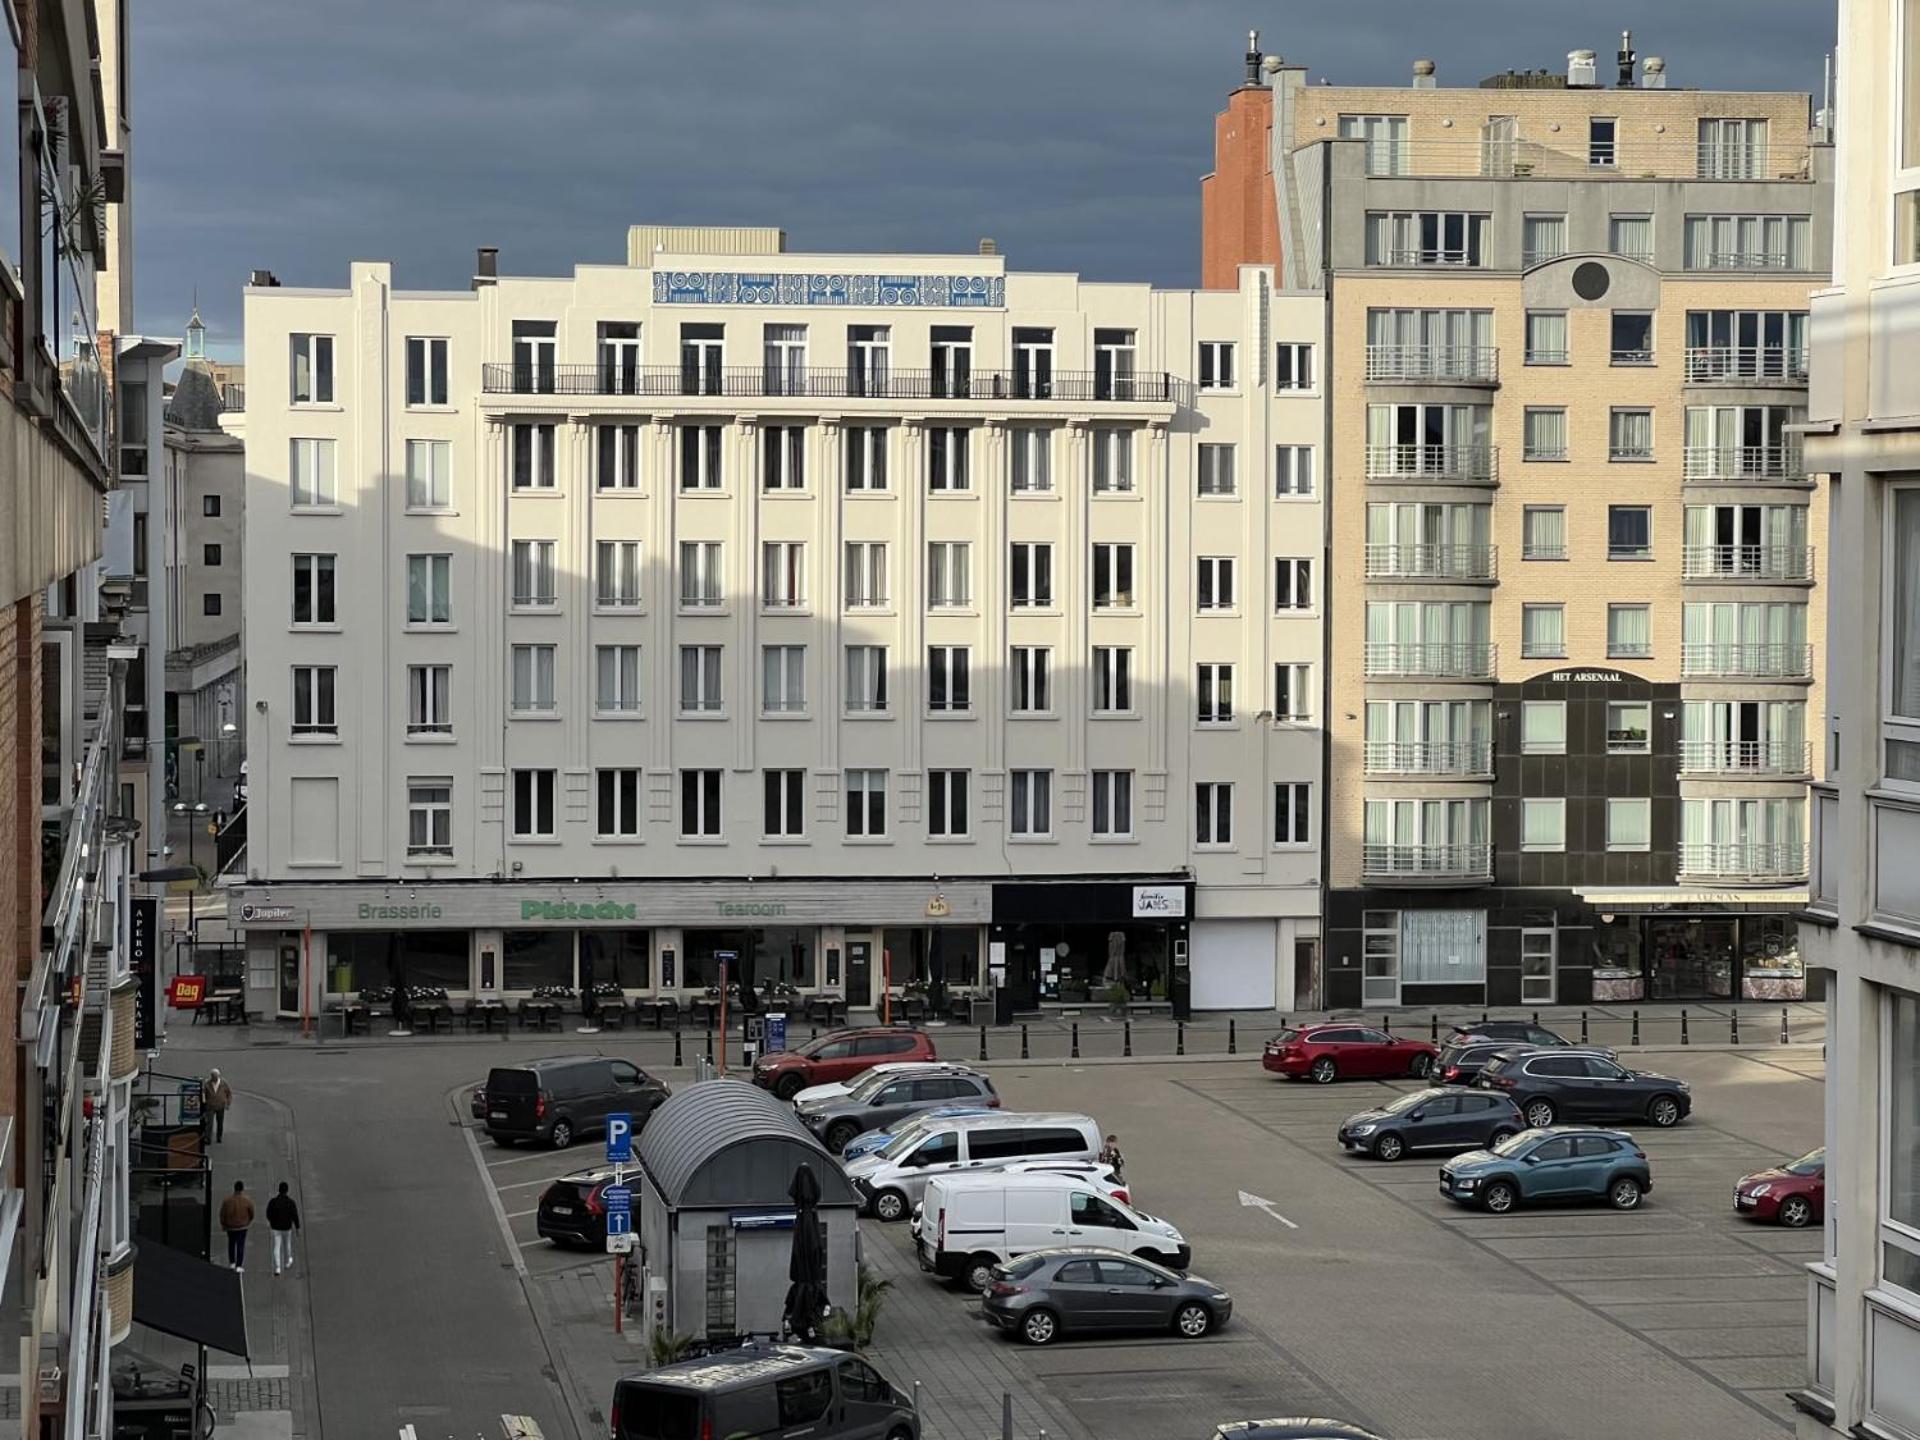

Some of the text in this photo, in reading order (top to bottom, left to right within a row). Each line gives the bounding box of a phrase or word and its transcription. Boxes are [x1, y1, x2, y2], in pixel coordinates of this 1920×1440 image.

[1552, 672, 1622, 682] HET ARSENAAL
[358, 902, 442, 919] Brasserie
[521, 900, 637, 920] Pistache
[715, 901, 786, 916] Tearoom
[134, 909, 143, 957] APERO
[135, 989, 144, 1039] ALACE
[610, 1120, 628, 1145] P
